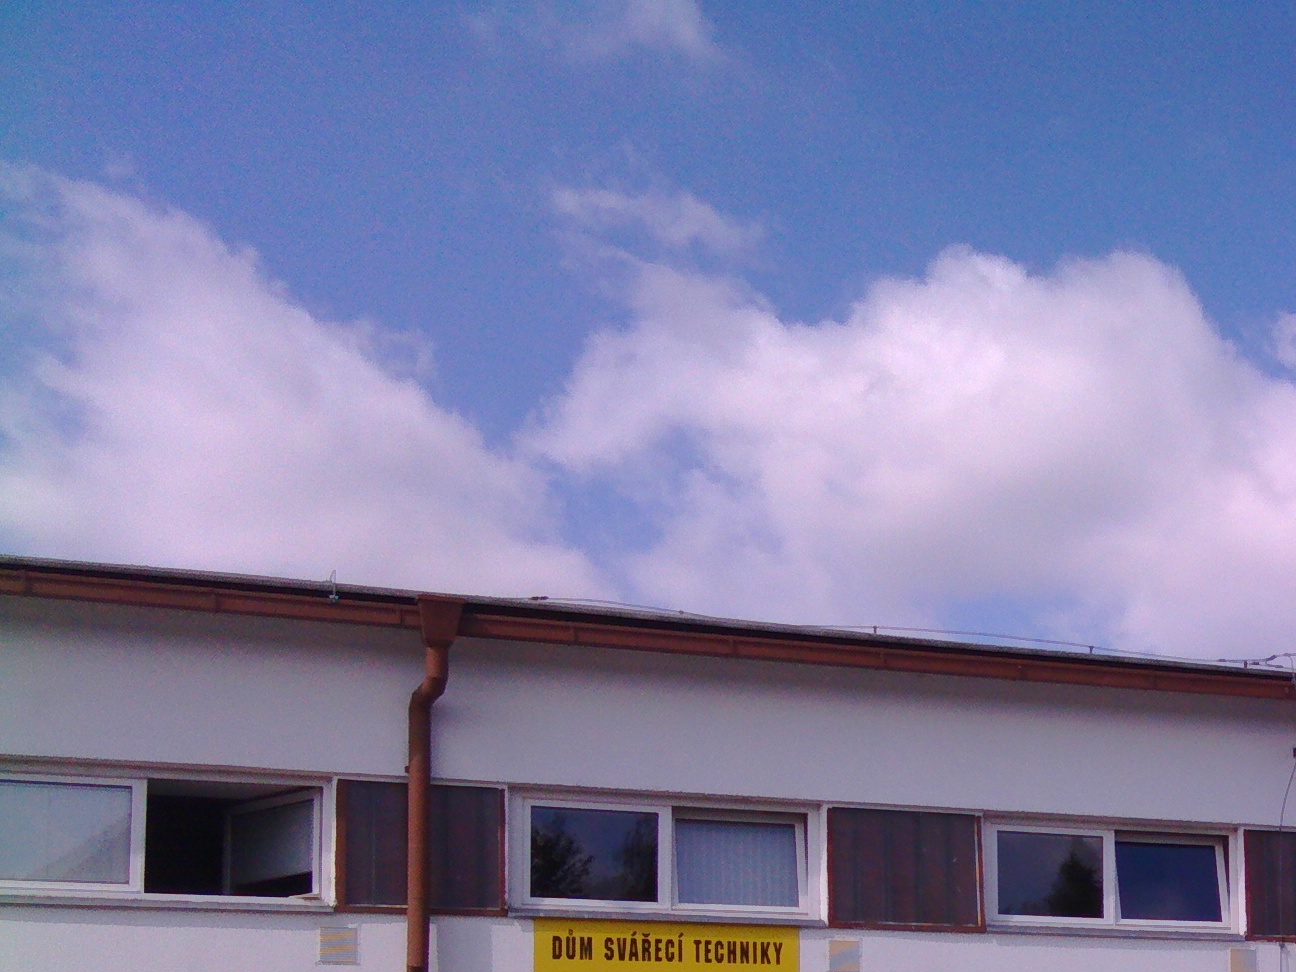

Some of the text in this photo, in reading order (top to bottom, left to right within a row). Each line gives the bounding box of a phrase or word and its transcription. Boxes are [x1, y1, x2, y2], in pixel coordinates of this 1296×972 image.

[552, 929, 783, 965] DŮM SVÁŘECÍ TECHNIKY
